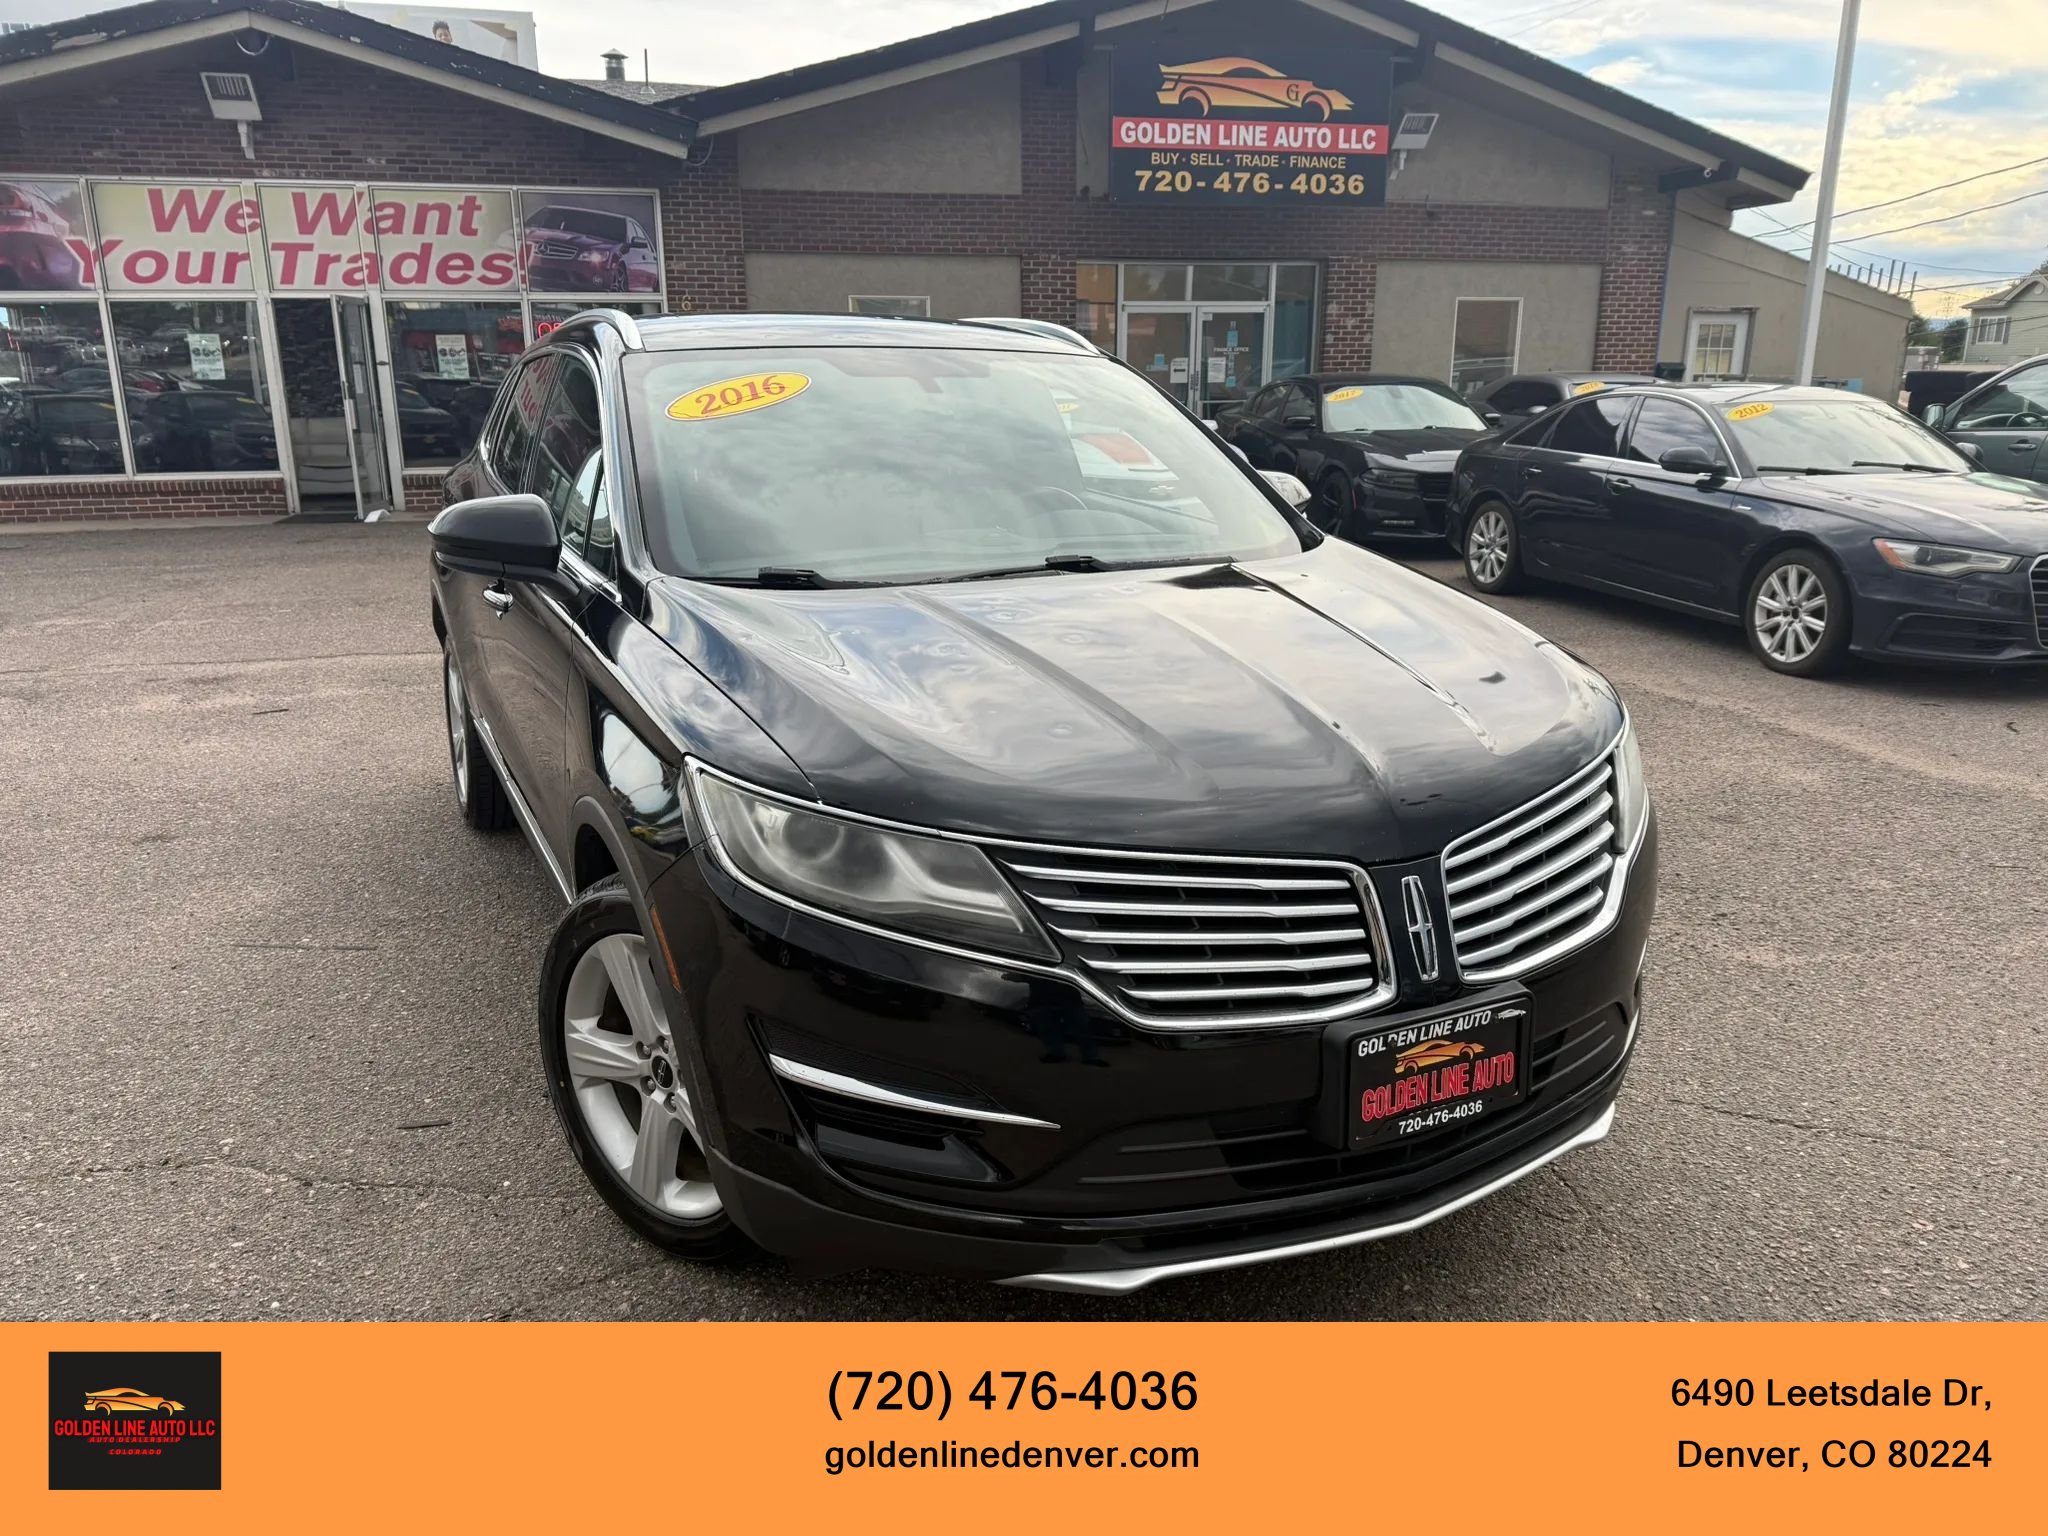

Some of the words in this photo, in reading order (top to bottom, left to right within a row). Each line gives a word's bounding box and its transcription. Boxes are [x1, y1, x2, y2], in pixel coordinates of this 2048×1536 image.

[1120, 121, 1211, 145] GOLDEN
[1218, 124, 1267, 147] LINE
[1274, 126, 1332, 148] AUTO
[1338, 129, 1376, 150] LLC
[1151, 152, 1180, 165] BUY
[1190, 153, 1224, 166] SELL
[1235, 154, 1279, 168] TRADE
[1289, 156, 1347, 169] FINANCE
[147, 188, 262, 234] We
[291, 191, 482, 237] Want
[65, 238, 250, 285] Your
[270, 242, 534, 287] Trades!
[695, 375, 786, 415] 2016
[1735, 403, 1769, 418] 2012
[1420, 1020, 1453, 1041] LINE
[1454, 1010, 1491, 1032] AUTO
[1361, 1073, 1428, 1122] GOLDEN
[1431, 1062, 1470, 1102] LINE
[1472, 1051, 1514, 1092] AUTO
[1398, 1100, 1483, 1135] 720-476-4036
